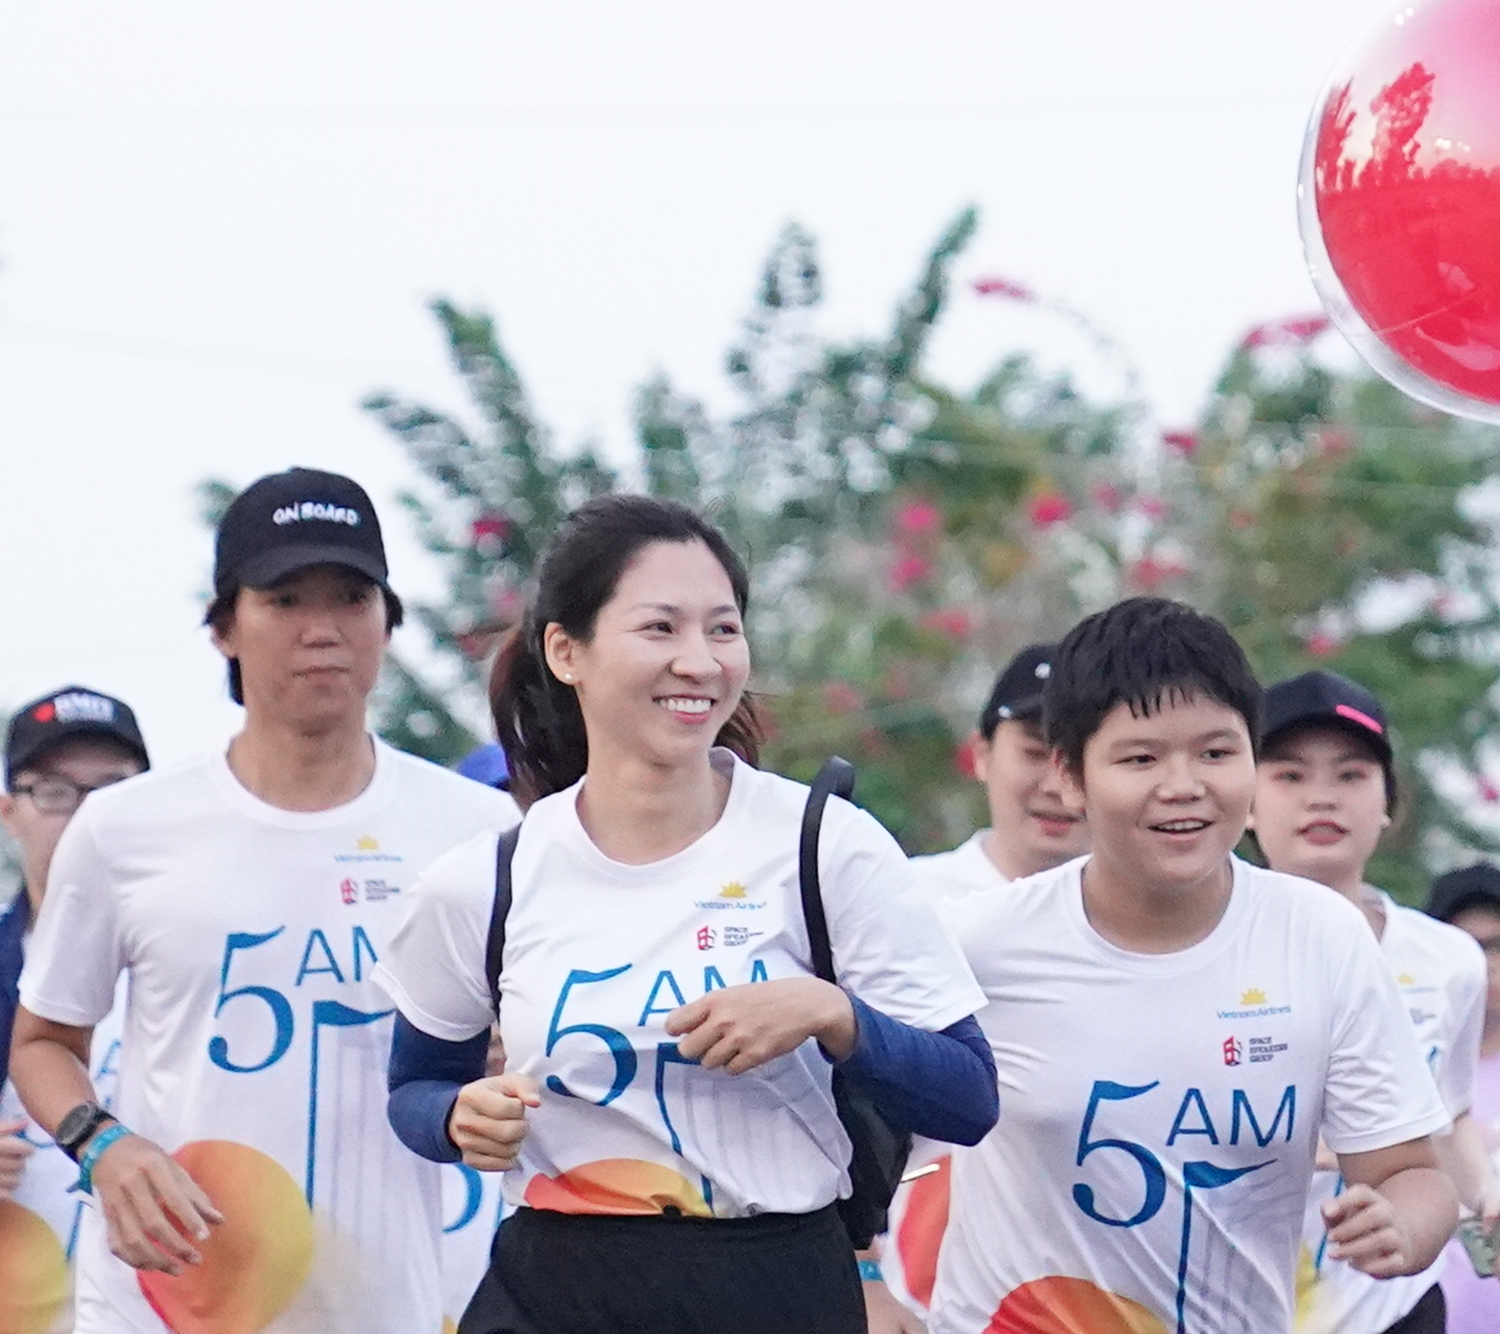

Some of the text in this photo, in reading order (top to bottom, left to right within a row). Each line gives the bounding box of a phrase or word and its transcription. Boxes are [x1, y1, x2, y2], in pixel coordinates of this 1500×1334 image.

[208, 925, 295, 1074] 5
[545, 963, 639, 1108] 5
[1072, 1080, 1296, 1229] 5 AM
